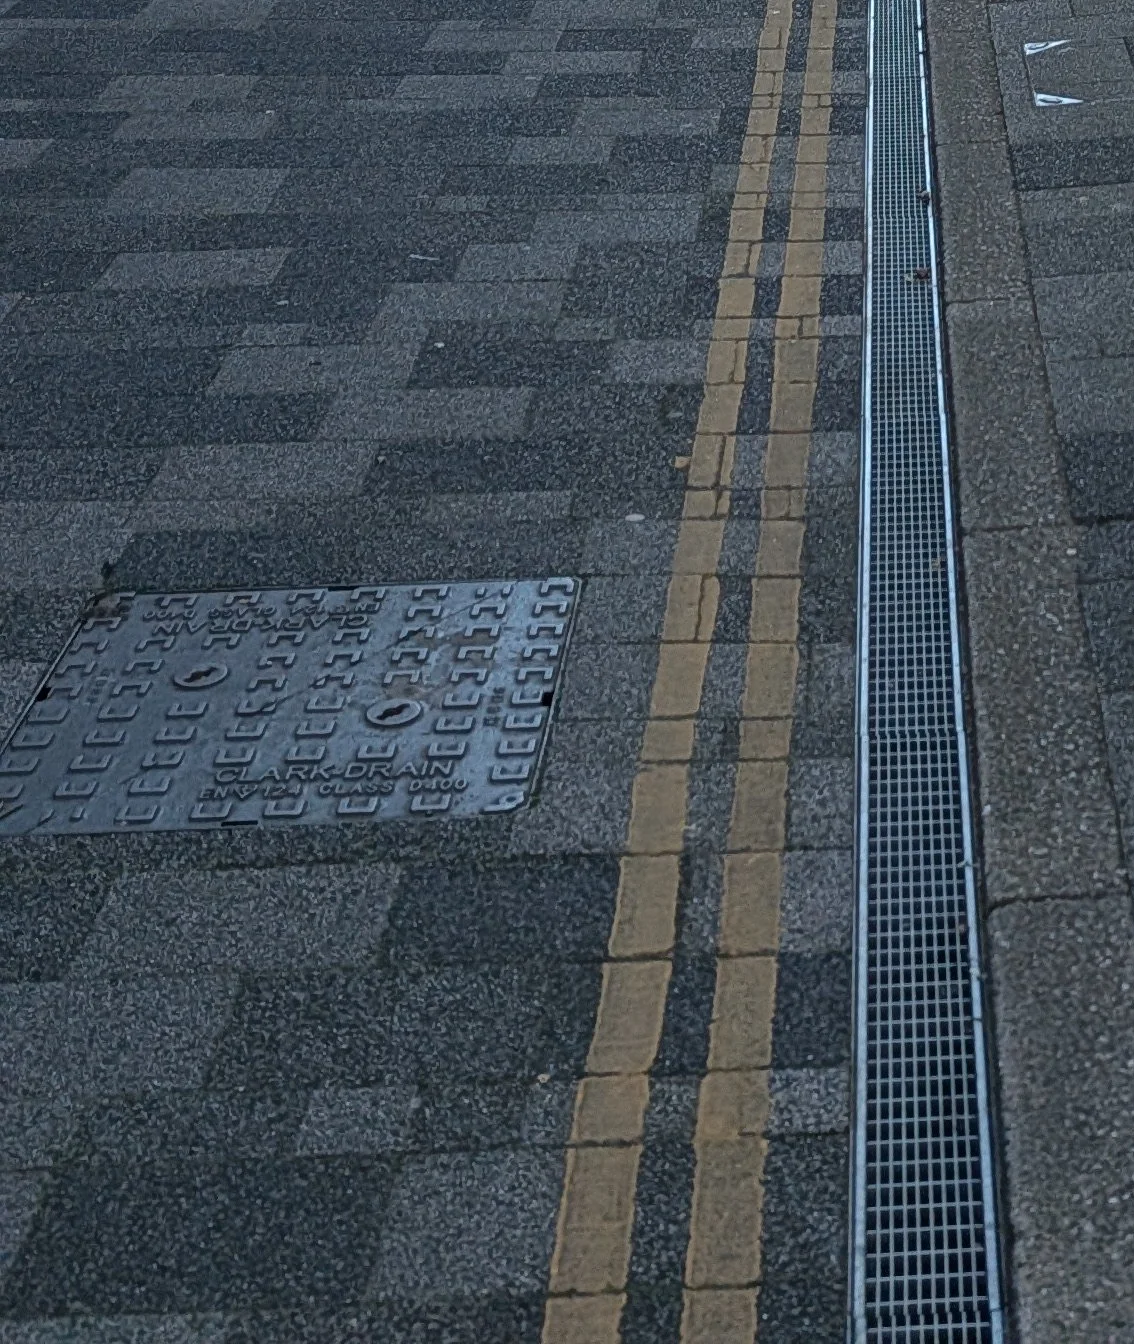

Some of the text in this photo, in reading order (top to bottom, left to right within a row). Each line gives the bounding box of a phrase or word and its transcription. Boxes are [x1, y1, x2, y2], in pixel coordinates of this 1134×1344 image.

[214, 760, 454, 783] CLARK-DRAIN
[318, 780, 395, 796] CLASS
[408, 778, 469, 793] D400
